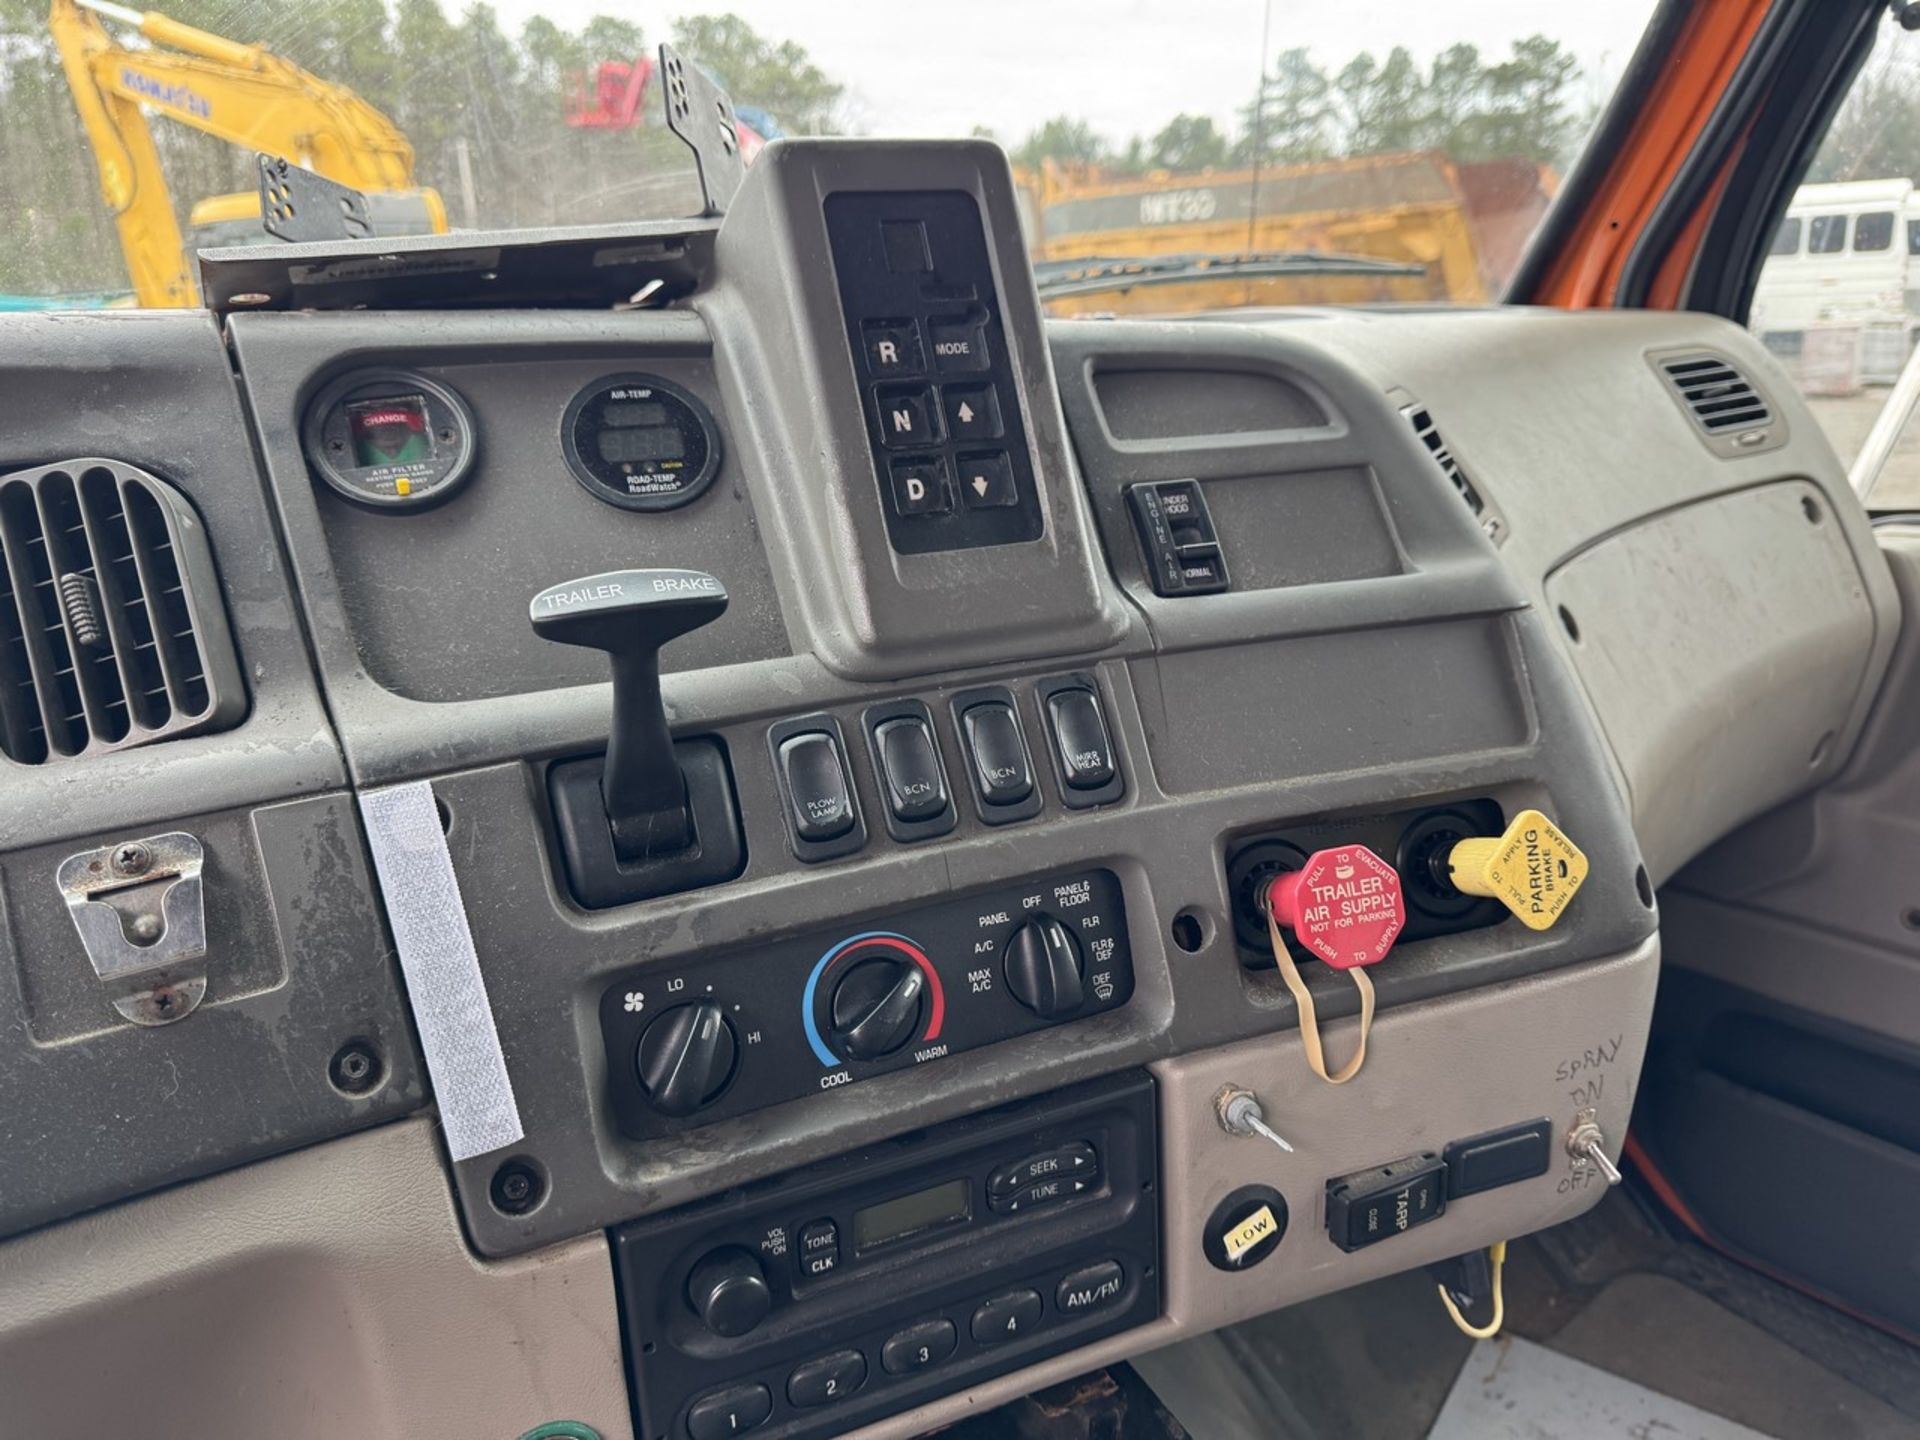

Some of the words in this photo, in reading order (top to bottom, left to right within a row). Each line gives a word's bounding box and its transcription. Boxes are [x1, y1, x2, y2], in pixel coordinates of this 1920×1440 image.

[878, 341, 898, 363] R
[936, 342, 970, 355] MODE
[611, 389, 652, 399] AIR-TEMP
[363, 414, 408, 427] CHANGE
[893, 410, 912, 432] N
[372, 468, 389, 476] AIR
[391, 463, 425, 473] FILTER
[626, 474, 676, 484] ROAD-TEMP
[906, 478, 925, 500] D
[1162, 494, 1189, 505] NDER
[542, 583, 625, 608] TRAILER
[652, 578, 717, 592] BRAKE
[1076, 750, 1098, 761] MIRR
[1079, 759, 1101, 769] HEAT
[991, 766, 1017, 779] BCN
[904, 782, 931, 795] BCN
[806, 796, 837, 811] PLOW
[810, 806, 838, 818] LAMP
[1545, 826, 1577, 859] RELEASE
[1307, 865, 1326, 887] PULL
[1336, 853, 1349, 863] TO
[1355, 849, 1397, 885] EVACUATE
[1492, 871, 1503, 884] TO
[1502, 838, 1522, 864] APPLY
[1525, 829, 1544, 914] PARKING
[1543, 848, 1555, 892] BRAKE
[1568, 875, 1578, 888] TO
[1311, 877, 1384, 903] TRAILER
[1022, 895, 1042, 909] OFF
[1059, 892, 1090, 908] FLOOR
[1304, 905, 1331, 923] AIR
[1341, 892, 1397, 915] SUPPLY
[1550, 892, 1567, 916] PUSH
[979, 912, 1010, 927] PANEL
[1082, 915, 1100, 928] FLR
[1310, 922, 1330, 933] NOT
[1334, 917, 1353, 928] FOR
[1358, 909, 1397, 923] PARKING
[974, 940, 994, 954] A/C
[1313, 937, 1338, 960] PUSH
[1353, 951, 1367, 961] TO
[1375, 918, 1399, 953] SUPPLY
[1096, 951, 1112, 962] DEF
[968, 968, 991, 983] MAX
[1092, 972, 1111, 985] DEF
[667, 978, 684, 992] LO
[972, 980, 992, 993] A/C
[747, 1031, 762, 1044] HI
[914, 1044, 948, 1062] WARM
[1555, 1034, 1623, 1081] SPRAY
[820, 1070, 853, 1089] COOL
[1568, 1074, 1604, 1106] ON
[1030, 1158, 1058, 1176] SEEK
[1556, 1168, 1597, 1194] OFF
[1031, 1183, 1058, 1200] TUNE
[767, 1227, 785, 1239] VOL
[807, 1232, 834, 1249] TONE
[1235, 1218, 1268, 1248] LOW
[761, 1236, 786, 1250] PUSH
[773, 1244, 787, 1255] ON
[811, 1256, 834, 1272] CLK
[1067, 1277, 1120, 1307] AM/FM
[1007, 1316, 1016, 1331] 4
[919, 1346, 929, 1362] 3
[826, 1380, 837, 1395] 2
[729, 1413, 737, 1429] 1
